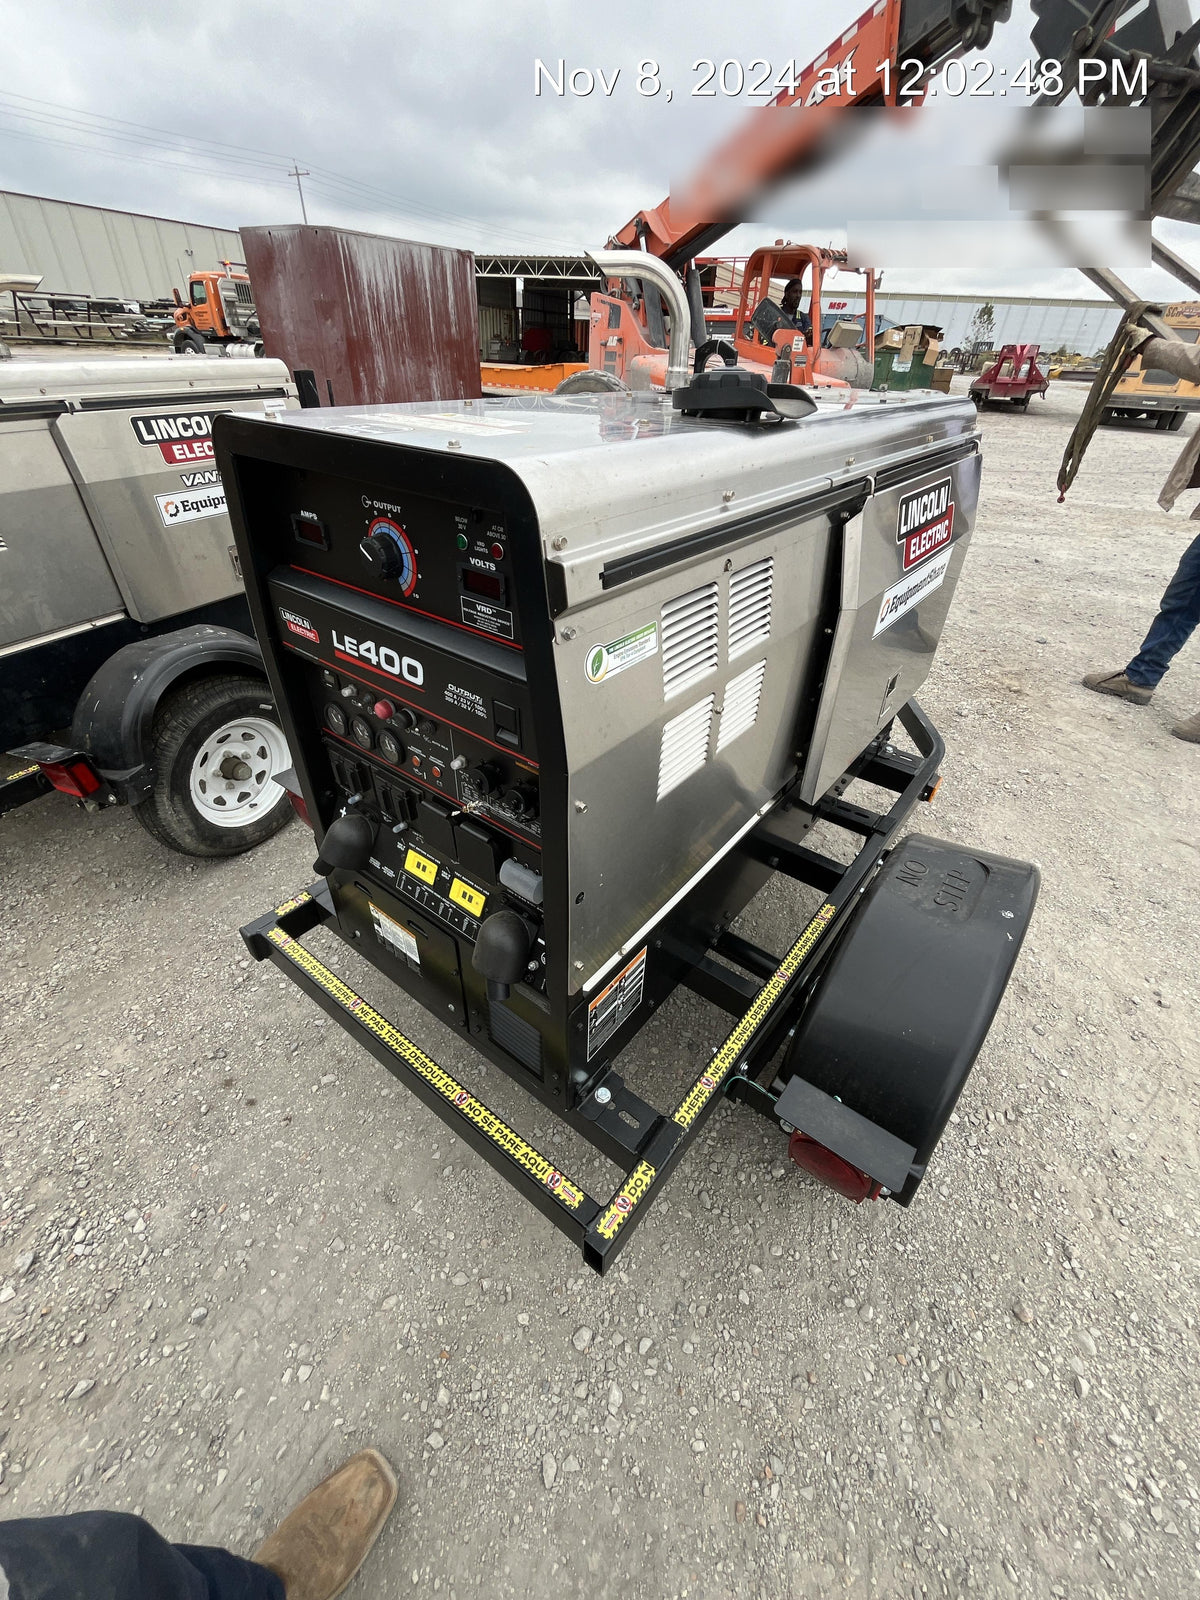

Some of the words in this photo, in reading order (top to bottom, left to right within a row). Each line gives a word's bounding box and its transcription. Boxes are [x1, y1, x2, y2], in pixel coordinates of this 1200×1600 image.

[828, 302, 847, 310] MSP
[137, 415, 212, 441] LINCO
[181, 470, 222, 487] VAN
[181, 495, 226, 513] Equip
[300, 510, 318, 520] AMPS
[373, 500, 402, 513] OUTPUT
[900, 484, 950, 535] LINCOLN
[909, 518, 950, 561] ELECTRIC
[469, 556, 496, 571] VOLTS
[889, 562, 947, 614] EquipmentShare
[281, 610, 311, 630] LINCOLN
[290, 623, 316, 640] ELECTRIC
[331, 629, 424, 686] LE400
[896, 860, 929, 888] NO
[786, 960, 795, 973] NO
[792, 950, 802, 963] SE
[798, 934, 813, 954] PARE
[288, 943, 301, 955] DO
[299, 952, 313, 967] NOT
[311, 964, 334, 985] STAND
[332, 982, 352, 1002] HERE
[710, 1062, 723, 1078] NE
[720, 1045, 736, 1066] PAS
[733, 1020, 754, 1048] TENEZ
[751, 988, 775, 1021] DEBOUT
[771, 980, 782, 992] ICI
[358, 1006, 371, 1019] NE
[369, 1015, 386, 1032] PAS
[385, 1030, 411, 1053] TENEZ
[409, 1050, 445, 1085] DEBOUT
[442, 1081, 457, 1095] ICI
[684, 1088, 706, 1116] HERE
[466, 1102, 482, 1118] NO
[481, 1114, 495, 1130] SE
[494, 1127, 523, 1154] PARE
[628, 1177, 643, 1198] DO
